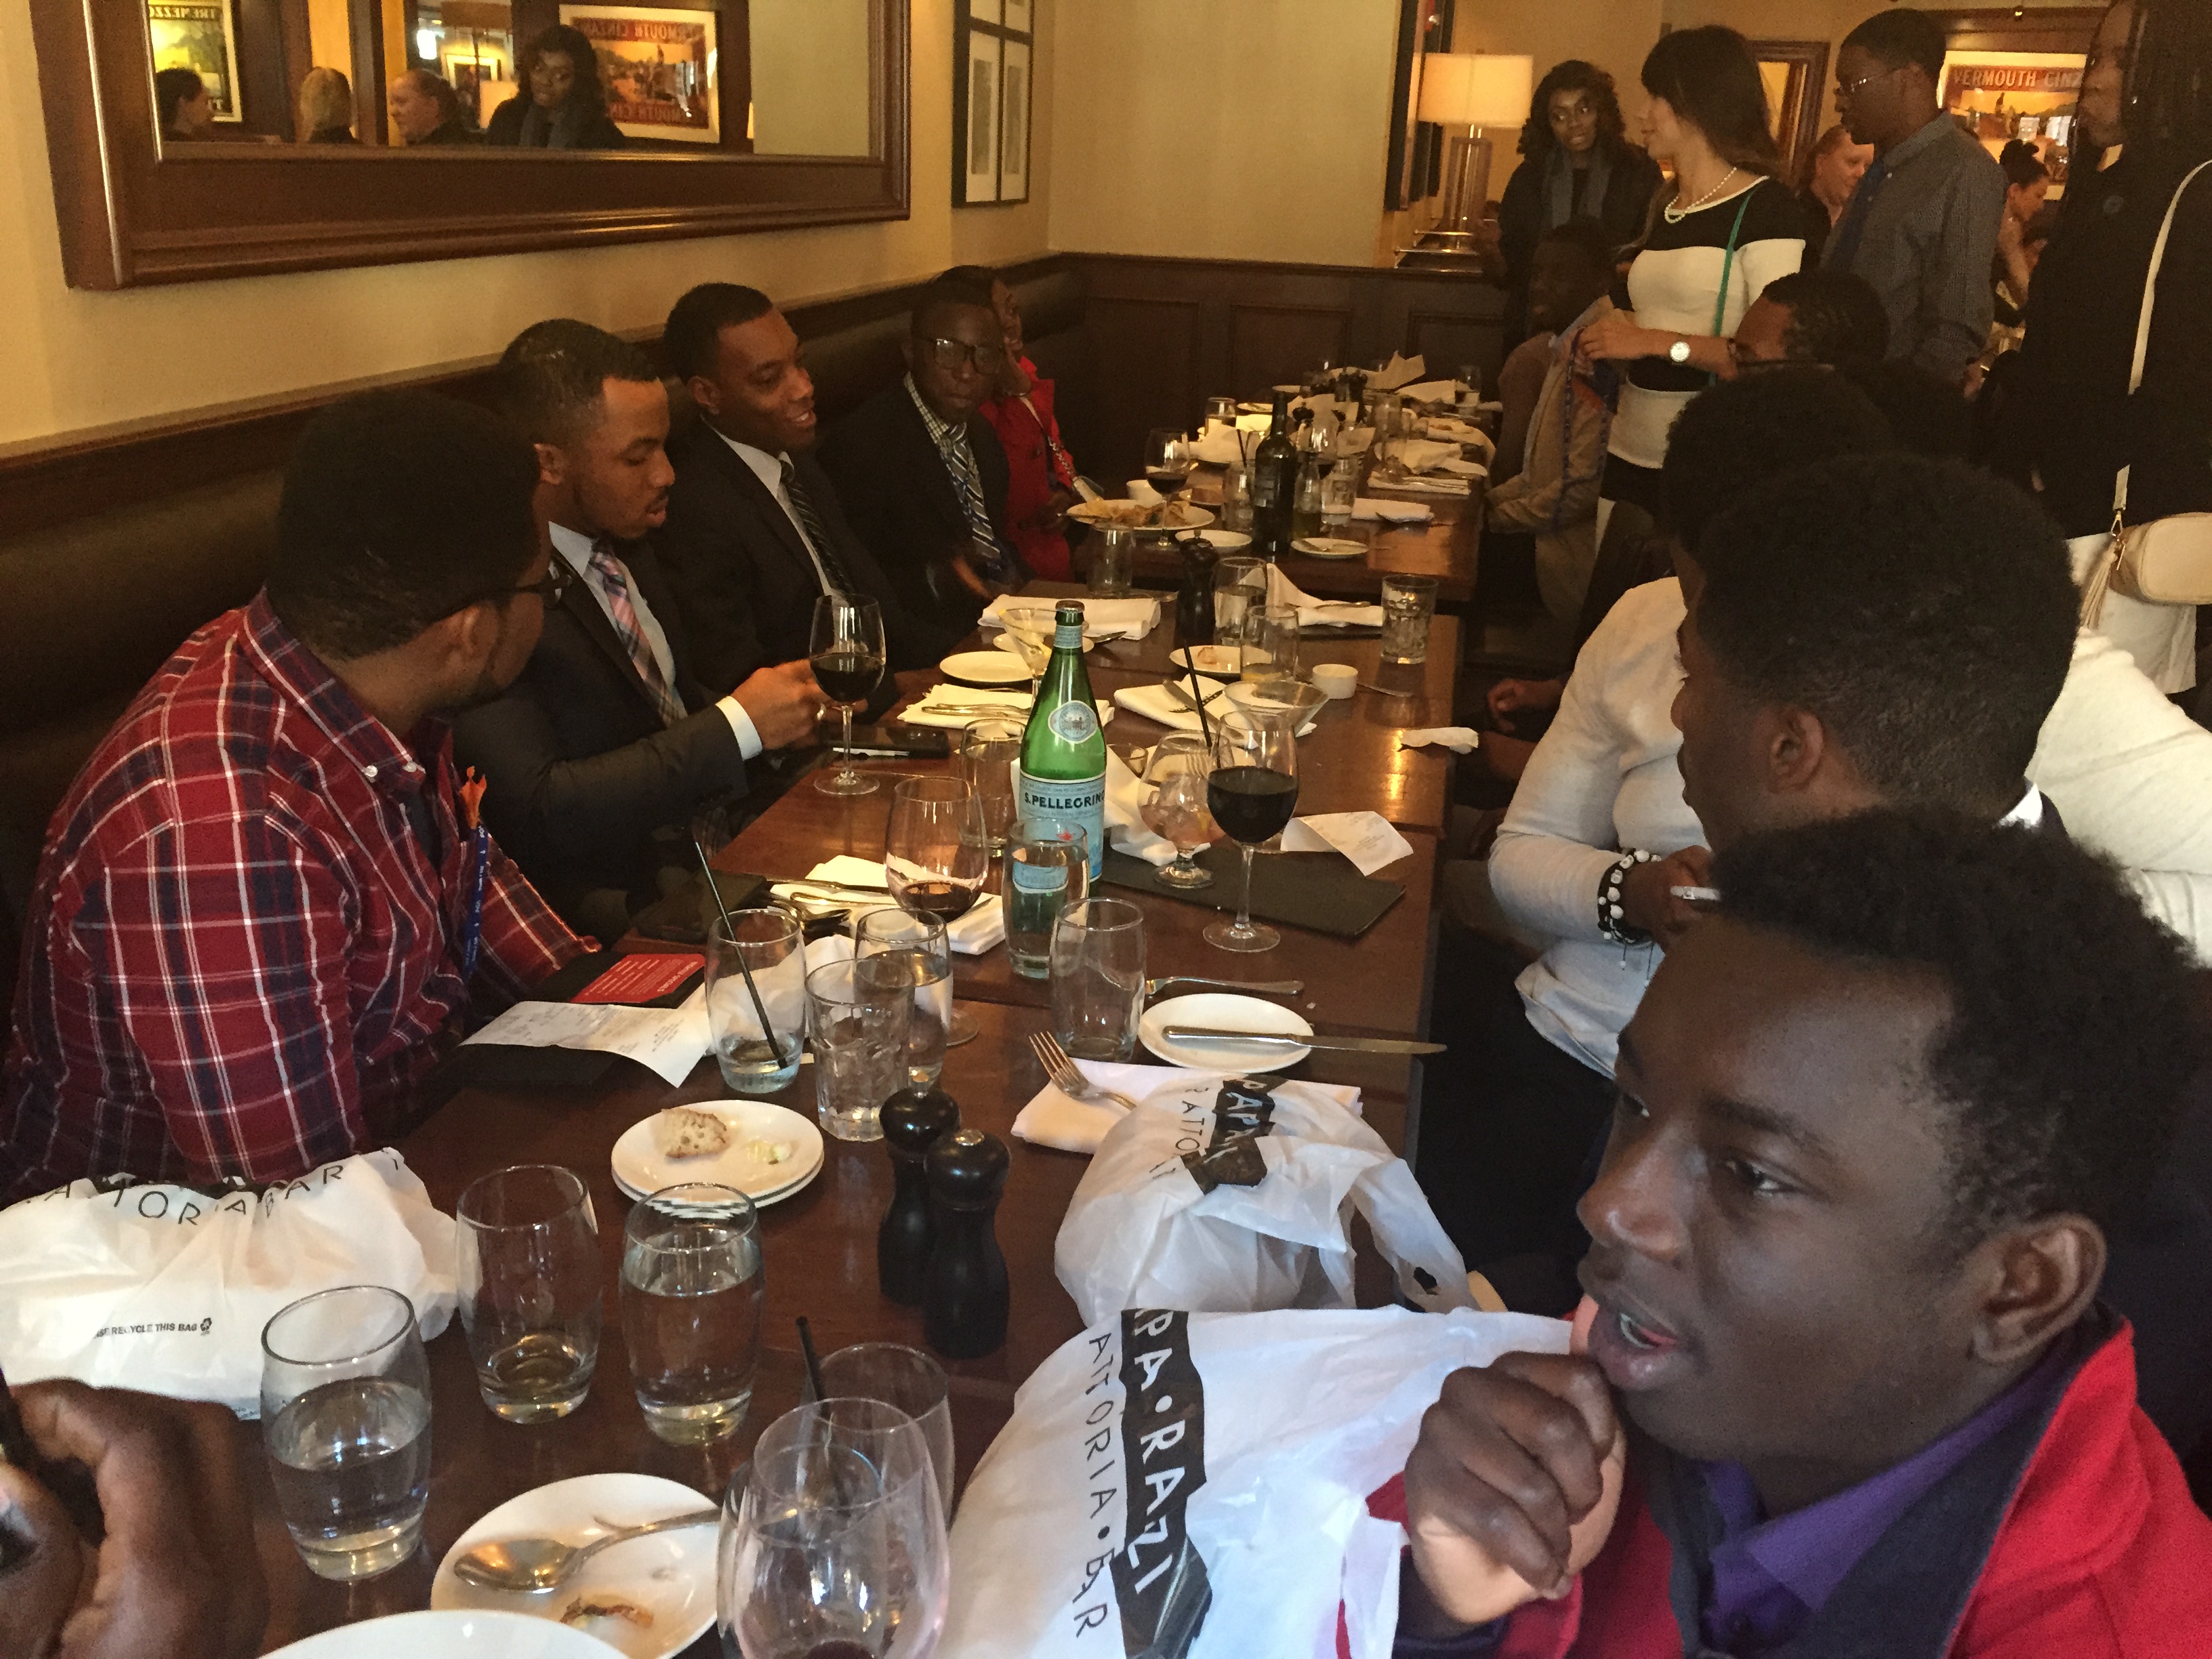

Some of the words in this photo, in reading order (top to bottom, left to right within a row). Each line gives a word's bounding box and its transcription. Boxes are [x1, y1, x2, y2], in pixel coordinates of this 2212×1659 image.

[1953, 70, 2036, 87] VERMOUTH
[155, 1322, 176, 1332] THIS
[178, 1323, 198, 1332] BAG
